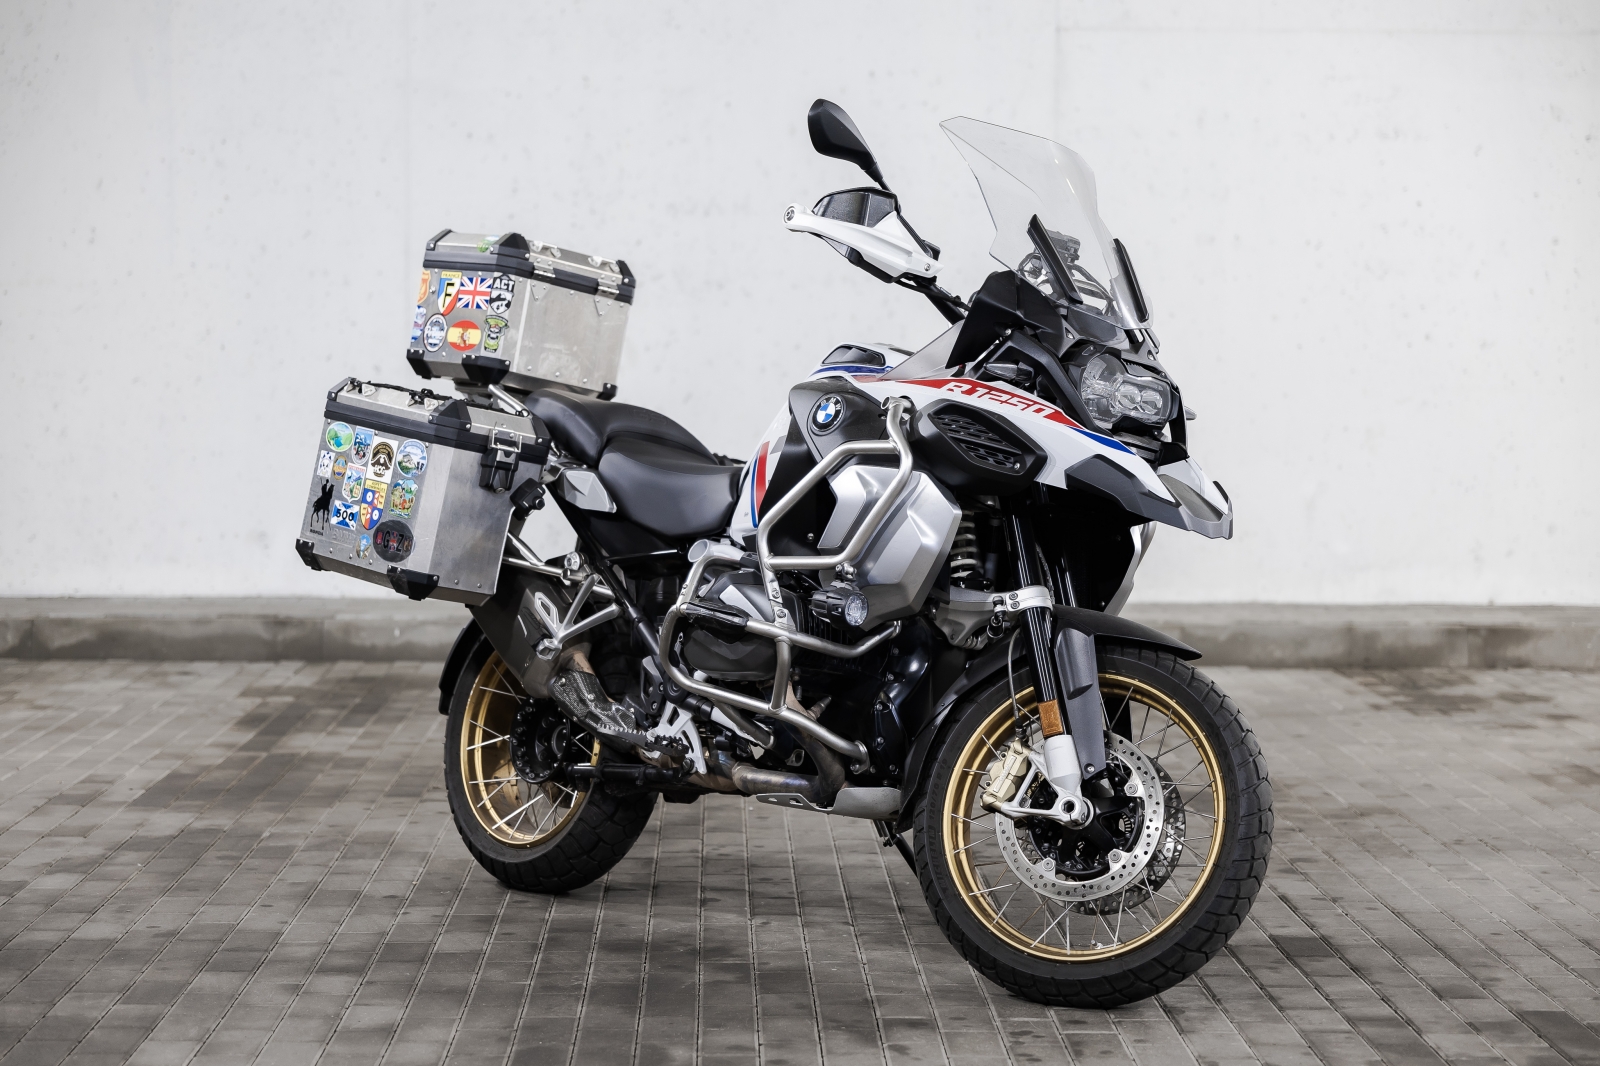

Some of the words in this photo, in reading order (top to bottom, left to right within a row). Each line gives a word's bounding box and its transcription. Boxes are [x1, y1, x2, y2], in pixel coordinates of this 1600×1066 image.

[493, 280, 515, 290] ACT
[443, 282, 455, 308] F
[335, 509, 354, 522] 500
